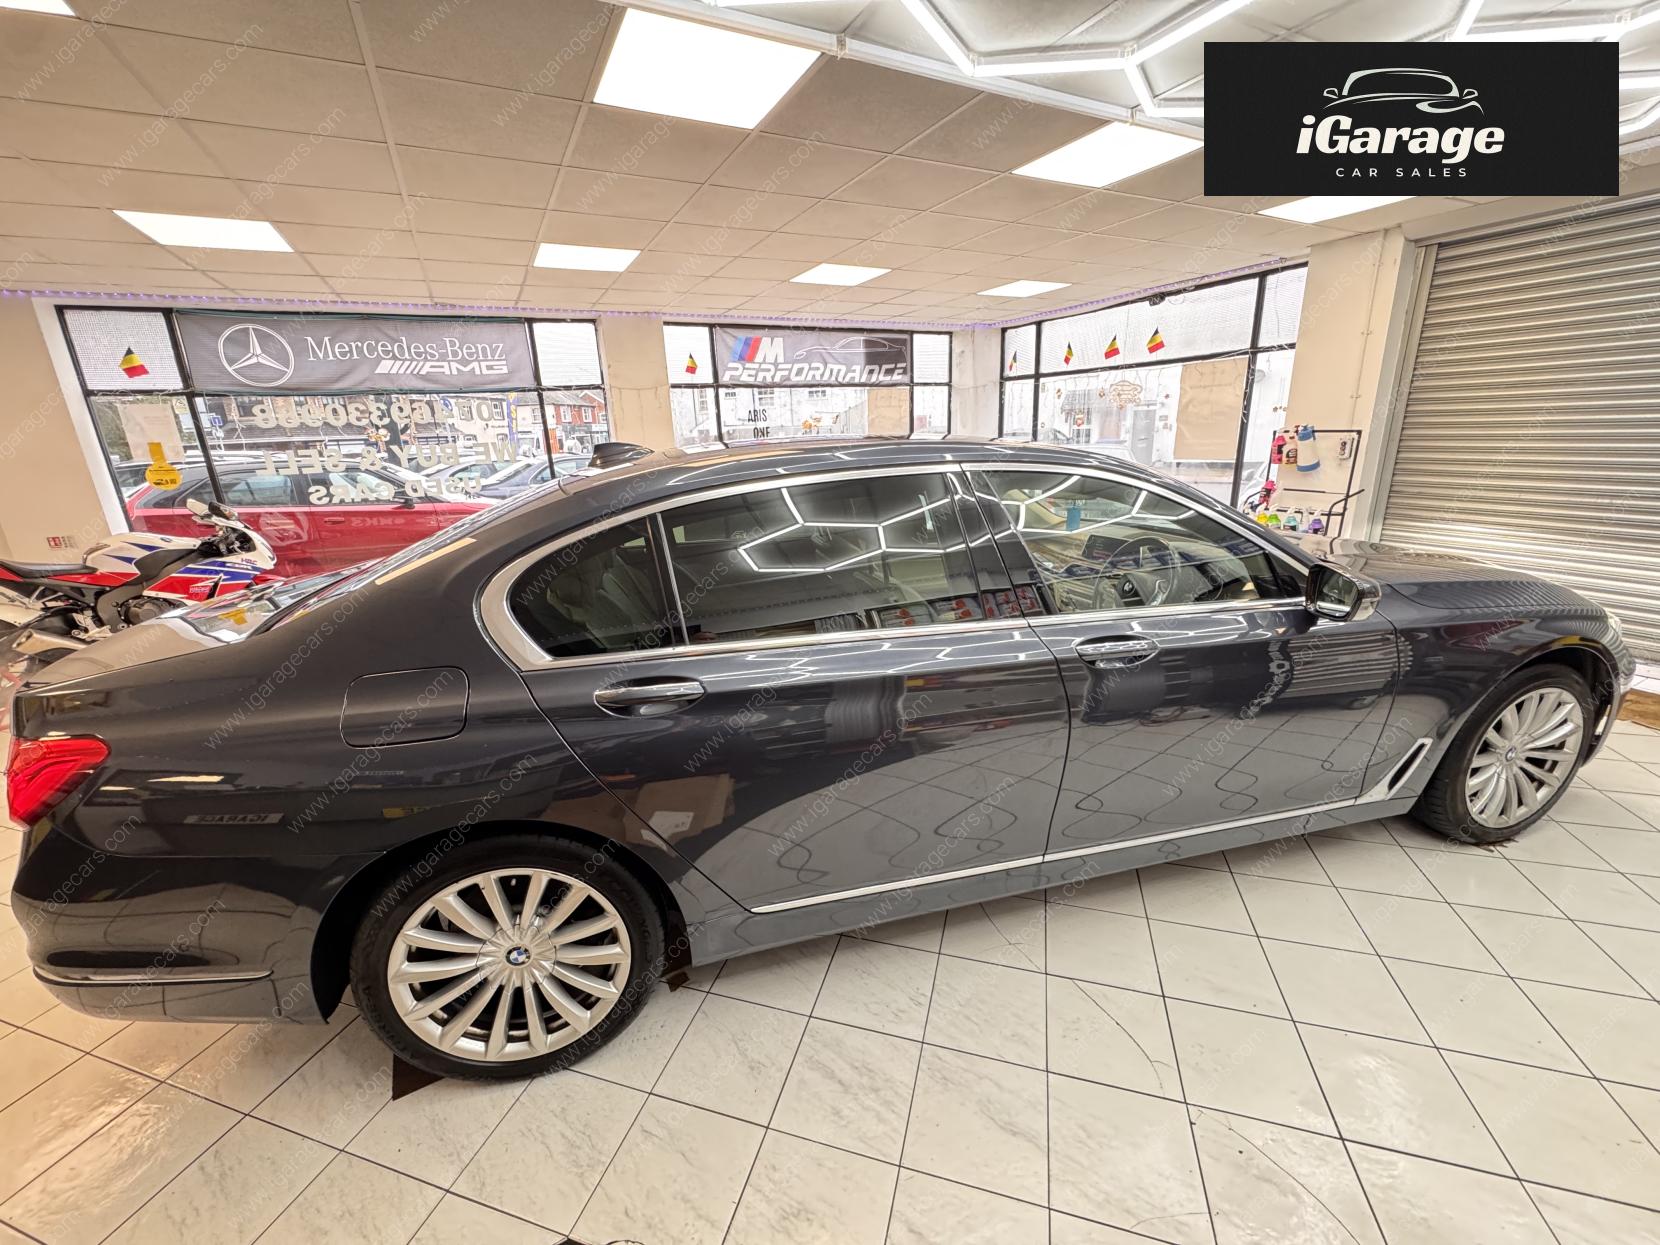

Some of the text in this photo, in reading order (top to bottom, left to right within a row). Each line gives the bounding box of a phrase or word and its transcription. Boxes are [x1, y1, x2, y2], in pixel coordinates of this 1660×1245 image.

[304, 336, 506, 361] Mercedes-Benz
[418, 360, 509, 375] AMG
[722, 362, 907, 383] PERFORMANCE
